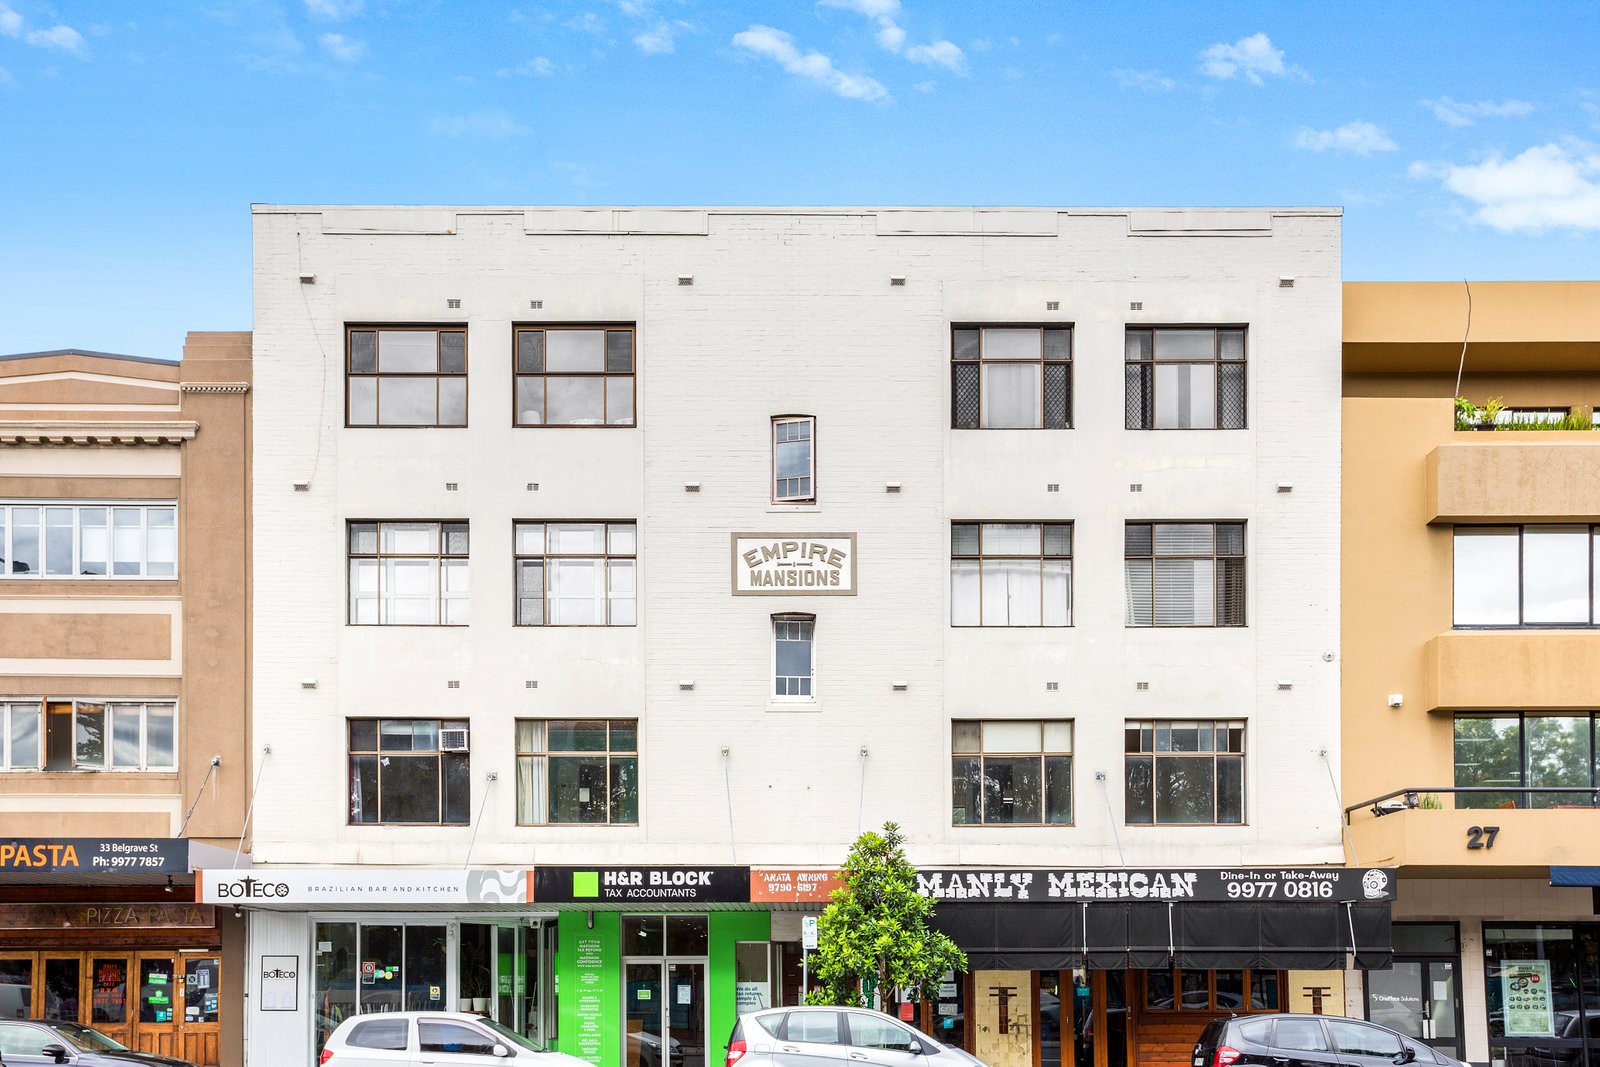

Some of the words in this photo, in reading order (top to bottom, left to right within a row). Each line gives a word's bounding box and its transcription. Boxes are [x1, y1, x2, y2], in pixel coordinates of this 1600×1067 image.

[742, 541, 847, 569] EMPIRE
[750, 569, 840, 587] MANSIONS
[1467, 826, 1500, 849] 27
[0, 845, 79, 867] PASTA
[100, 843, 110, 852] 33
[112, 843, 147, 854] Belgrave
[149, 843, 158, 852] St
[92, 857, 110, 867] Ph:
[111, 857, 139, 867] 9977
[139, 857, 165, 867] 7857
[604, 871, 643, 885] H&R
[649, 871, 711, 885] BLOCK
[796, 873, 828, 882] AWNING
[1220, 871, 1260, 880] Dine-In
[1280, 870, 1339, 881] Take-Away
[217, 875, 289, 897] BOTECO
[604, 888, 622, 898] TAX
[626, 888, 697, 898] ACCOUNTANTS
[916, 872, 1033, 899] MANLY
[1048, 872, 1197, 898] MEXICAN
[1227, 881, 1277, 898] 9977
[1284, 881, 1333, 898] 0816
[86, 907, 138, 925] PIZZA
[150, 907, 204, 924] PASTA
[263, 968, 296, 979] BOTECO
